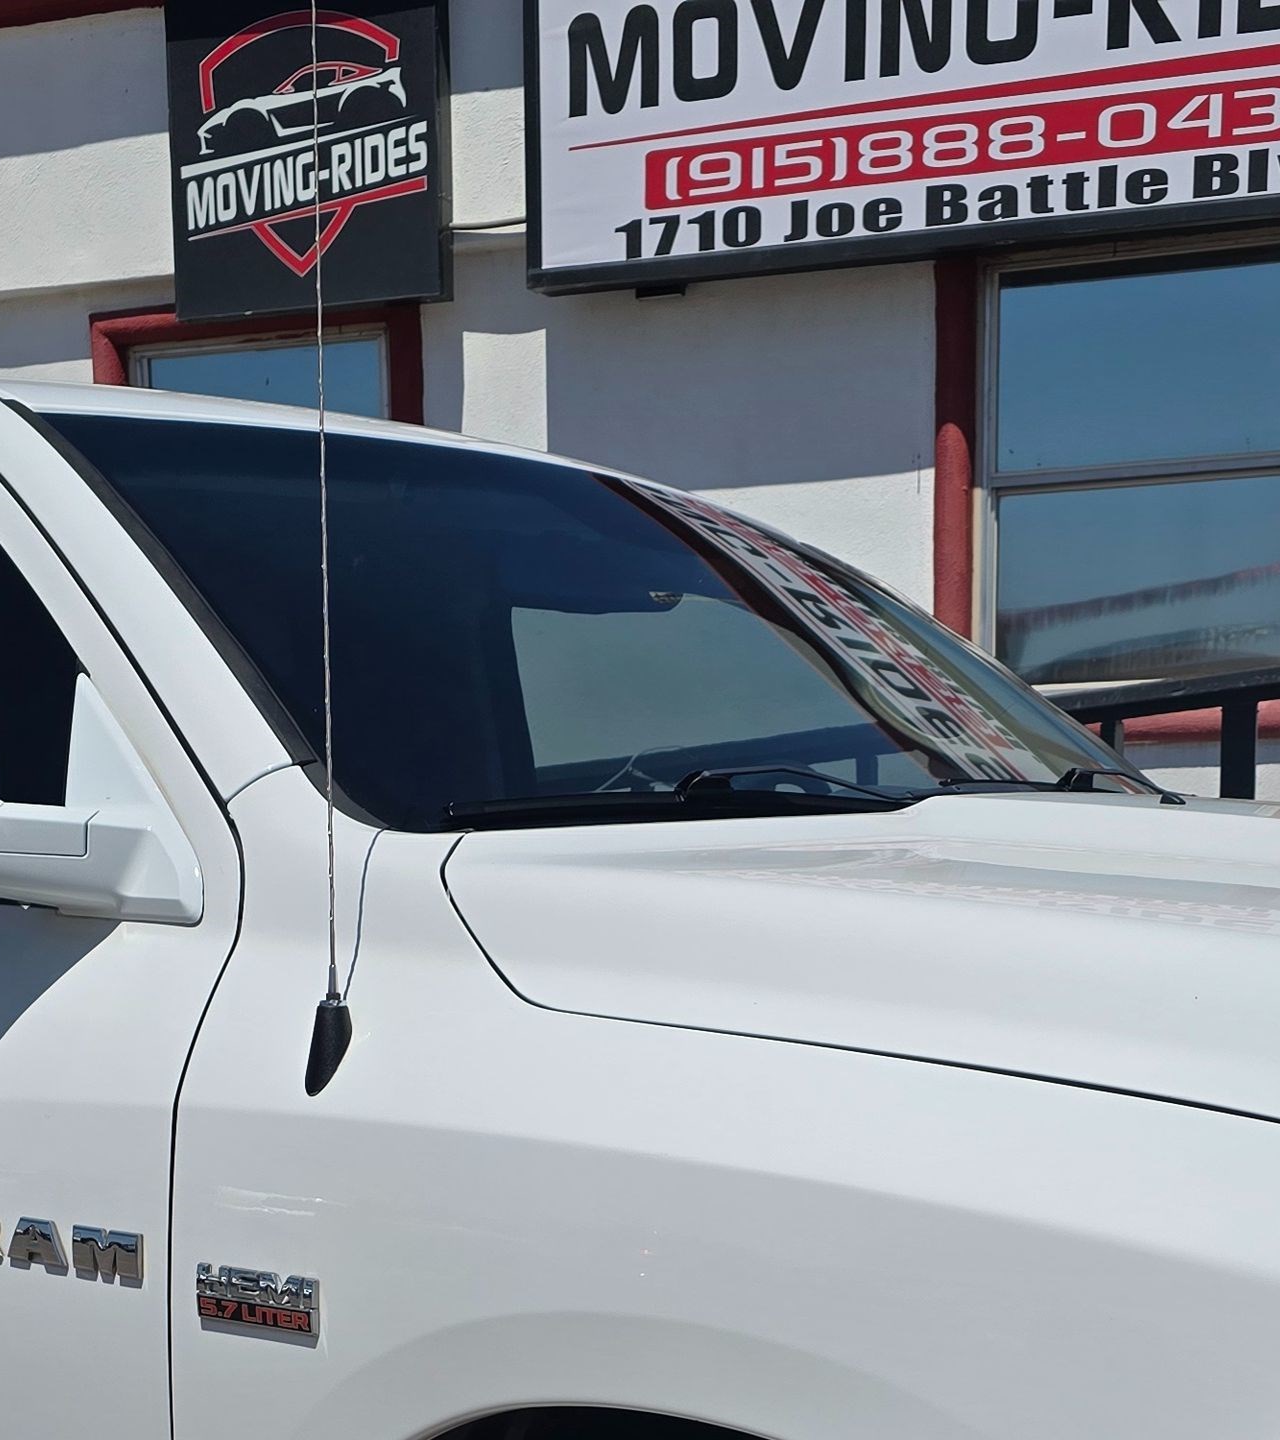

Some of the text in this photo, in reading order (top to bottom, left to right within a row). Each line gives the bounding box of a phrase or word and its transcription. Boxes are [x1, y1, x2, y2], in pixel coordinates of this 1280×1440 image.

[186, 120, 428, 232] MOVING-RIDES
[615, 206, 761, 261] 1710
[784, 197, 902, 243] Joe
[925, 165, 1169, 228] Battle
[196, 1261, 319, 1310] HEMI
[199, 1297, 310, 1331] 5.7 LITER
